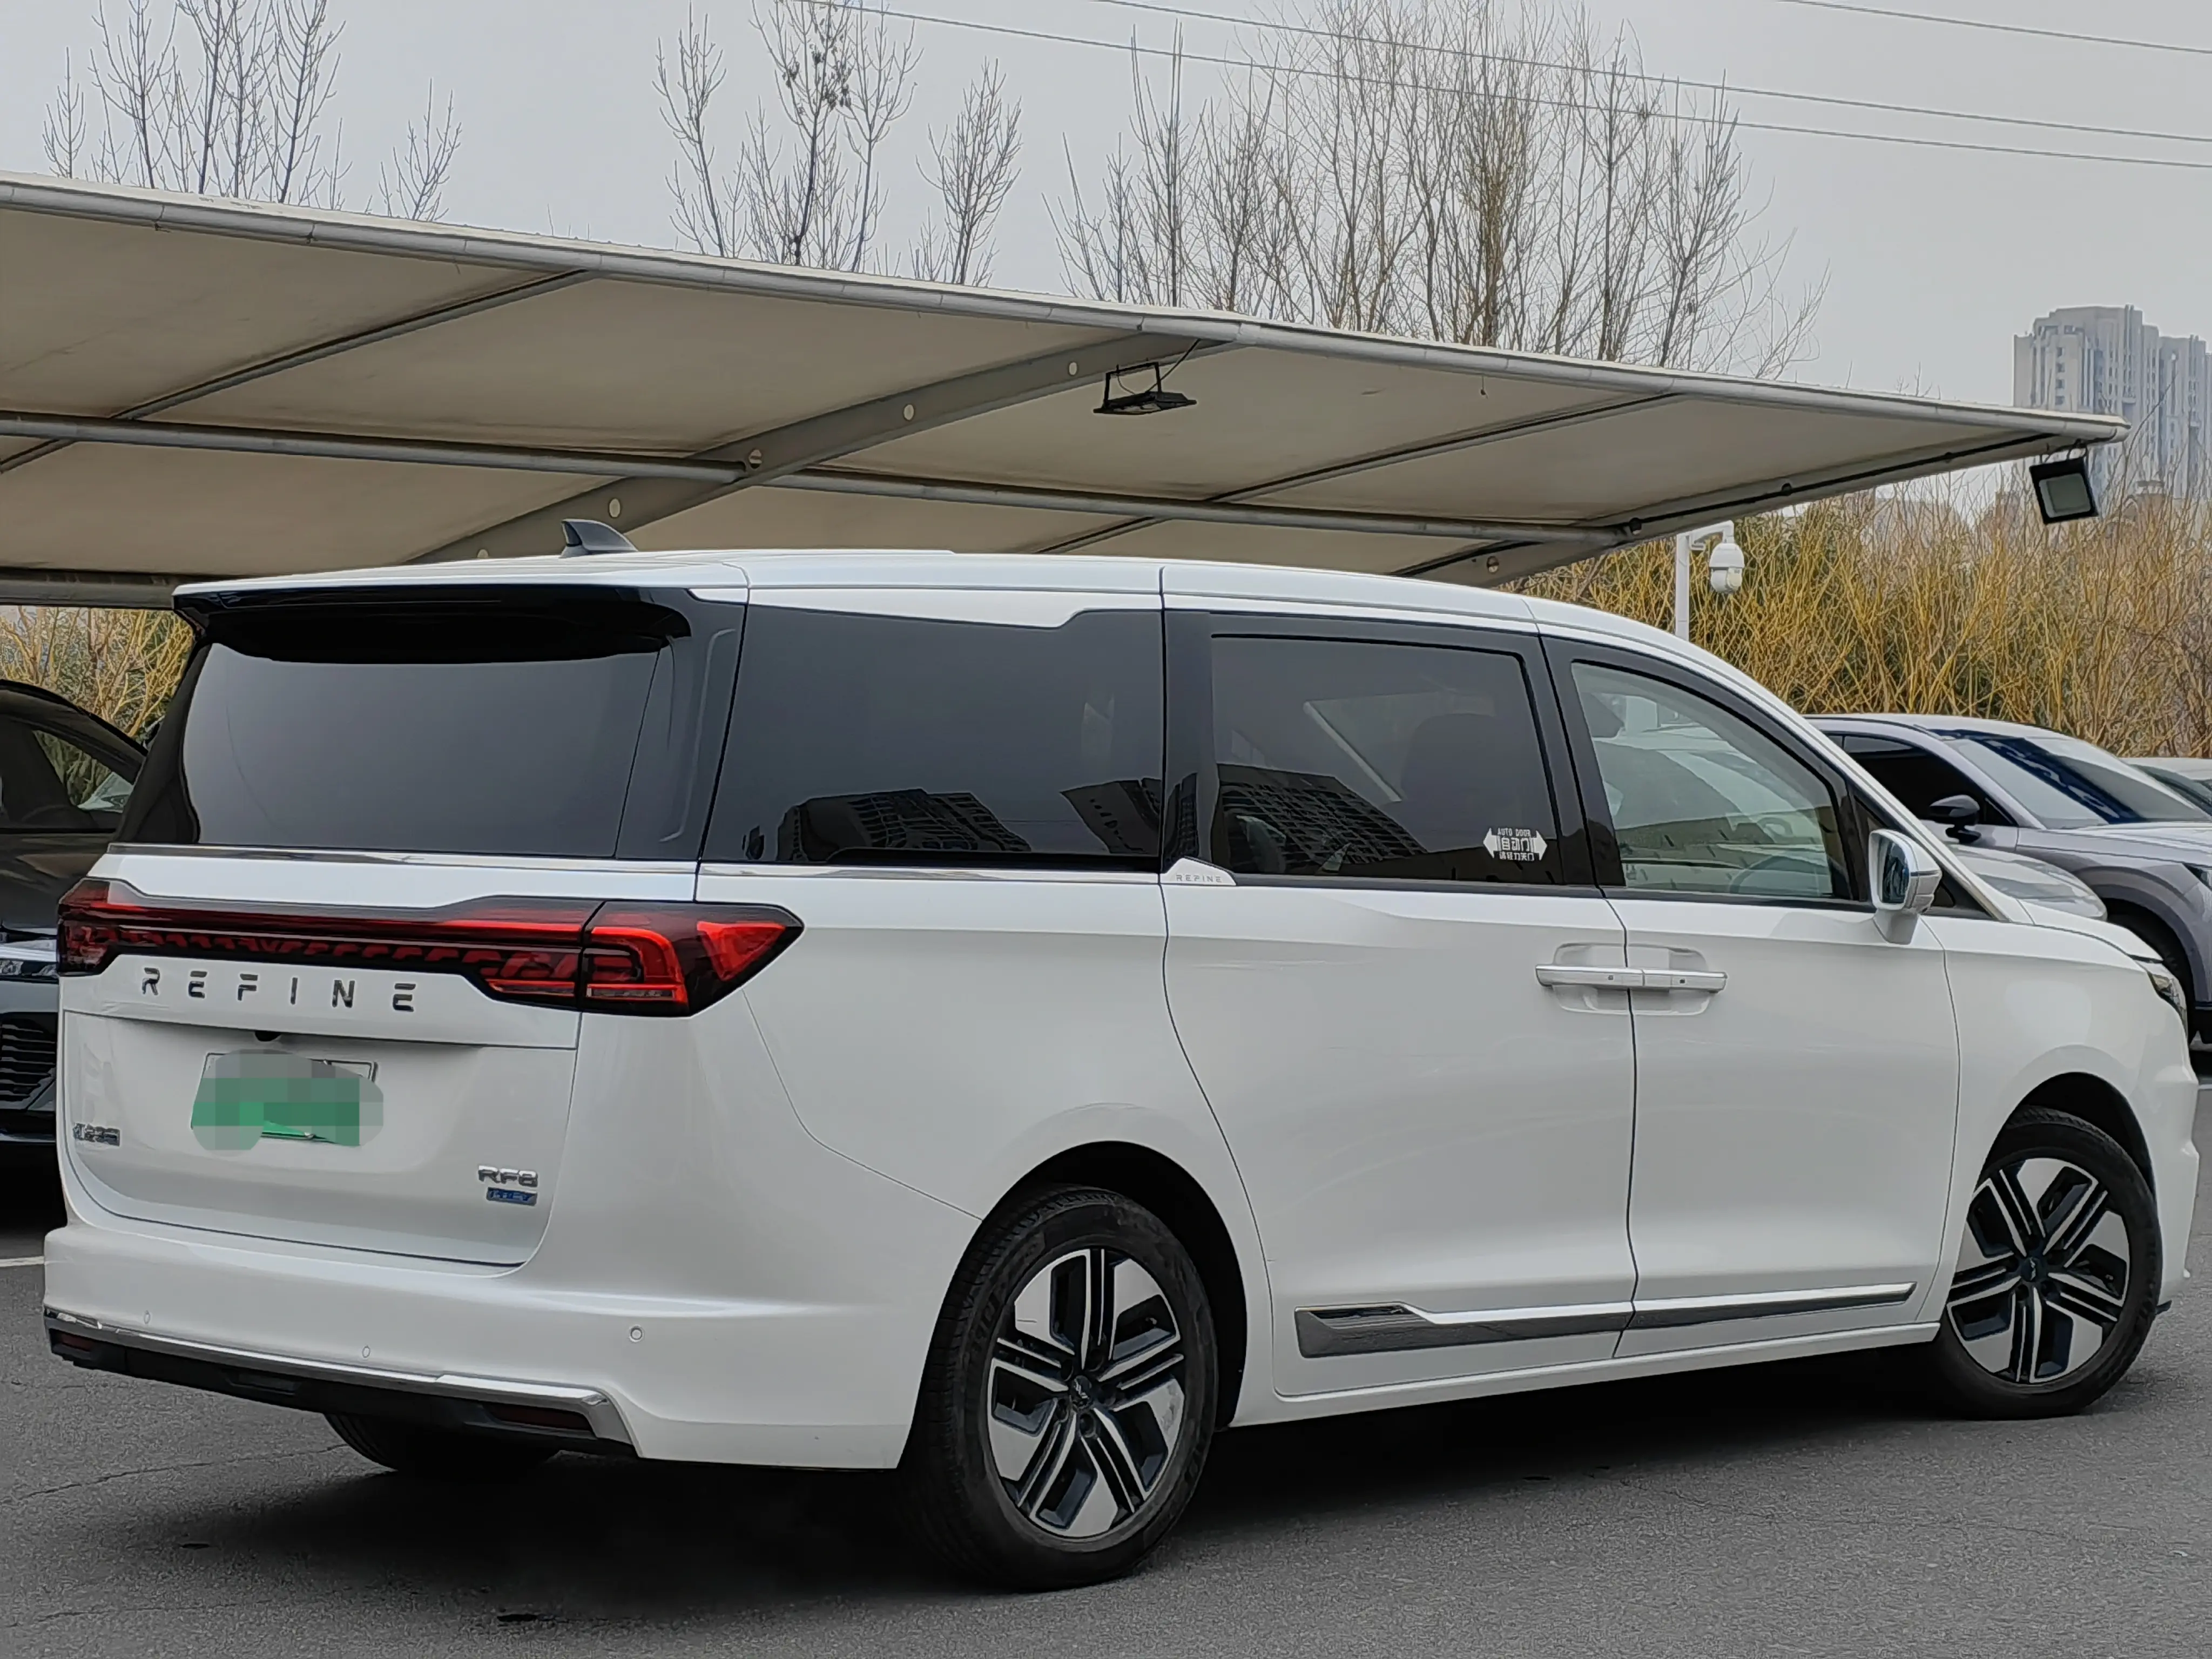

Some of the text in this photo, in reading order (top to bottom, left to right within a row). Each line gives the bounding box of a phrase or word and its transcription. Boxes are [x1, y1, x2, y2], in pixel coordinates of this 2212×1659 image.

[1498, 828, 1531, 837] AUTO DOOR
[1501, 837, 1530, 852] 自动门
[1176, 874, 1223, 883] REFINE
[142, 967, 416, 1012] REFINE
